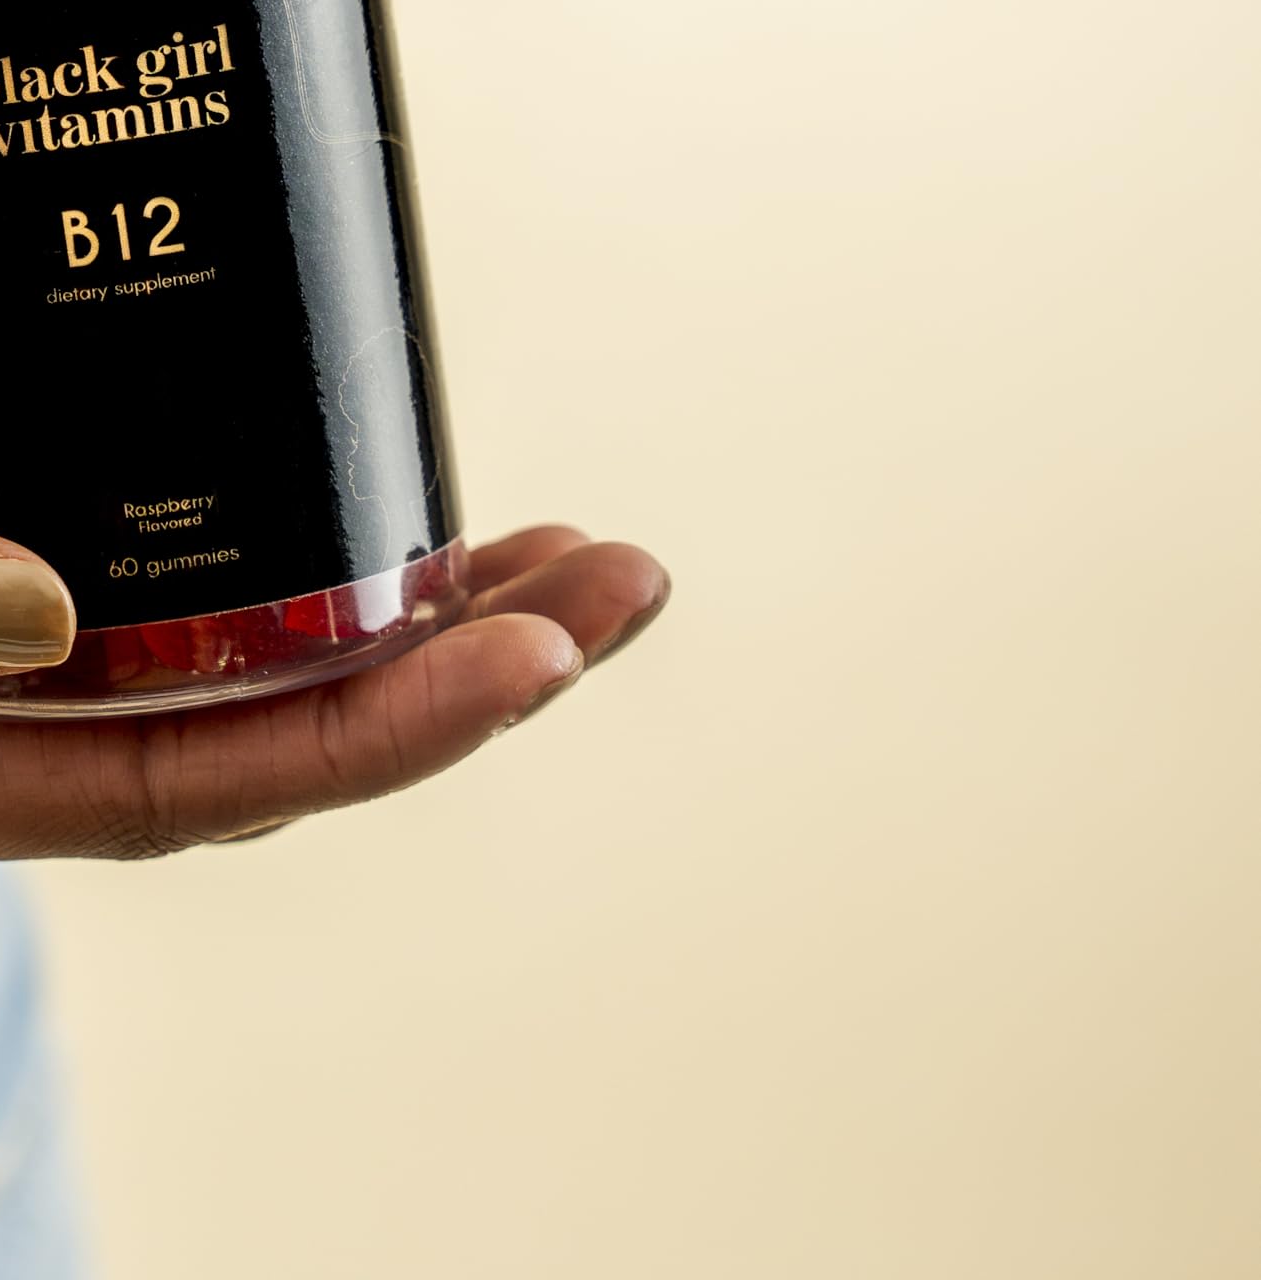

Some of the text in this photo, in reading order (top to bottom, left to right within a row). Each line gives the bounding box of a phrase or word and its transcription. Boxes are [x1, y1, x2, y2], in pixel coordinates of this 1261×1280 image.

[136, 23, 236, 98] girl
[61, 196, 186, 268] B12
[46, 267, 216, 304] dietary supplement
[123, 495, 215, 518] Raspberry
[138, 512, 203, 533] Flavored
[109, 547, 240, 578] 60 gummies
